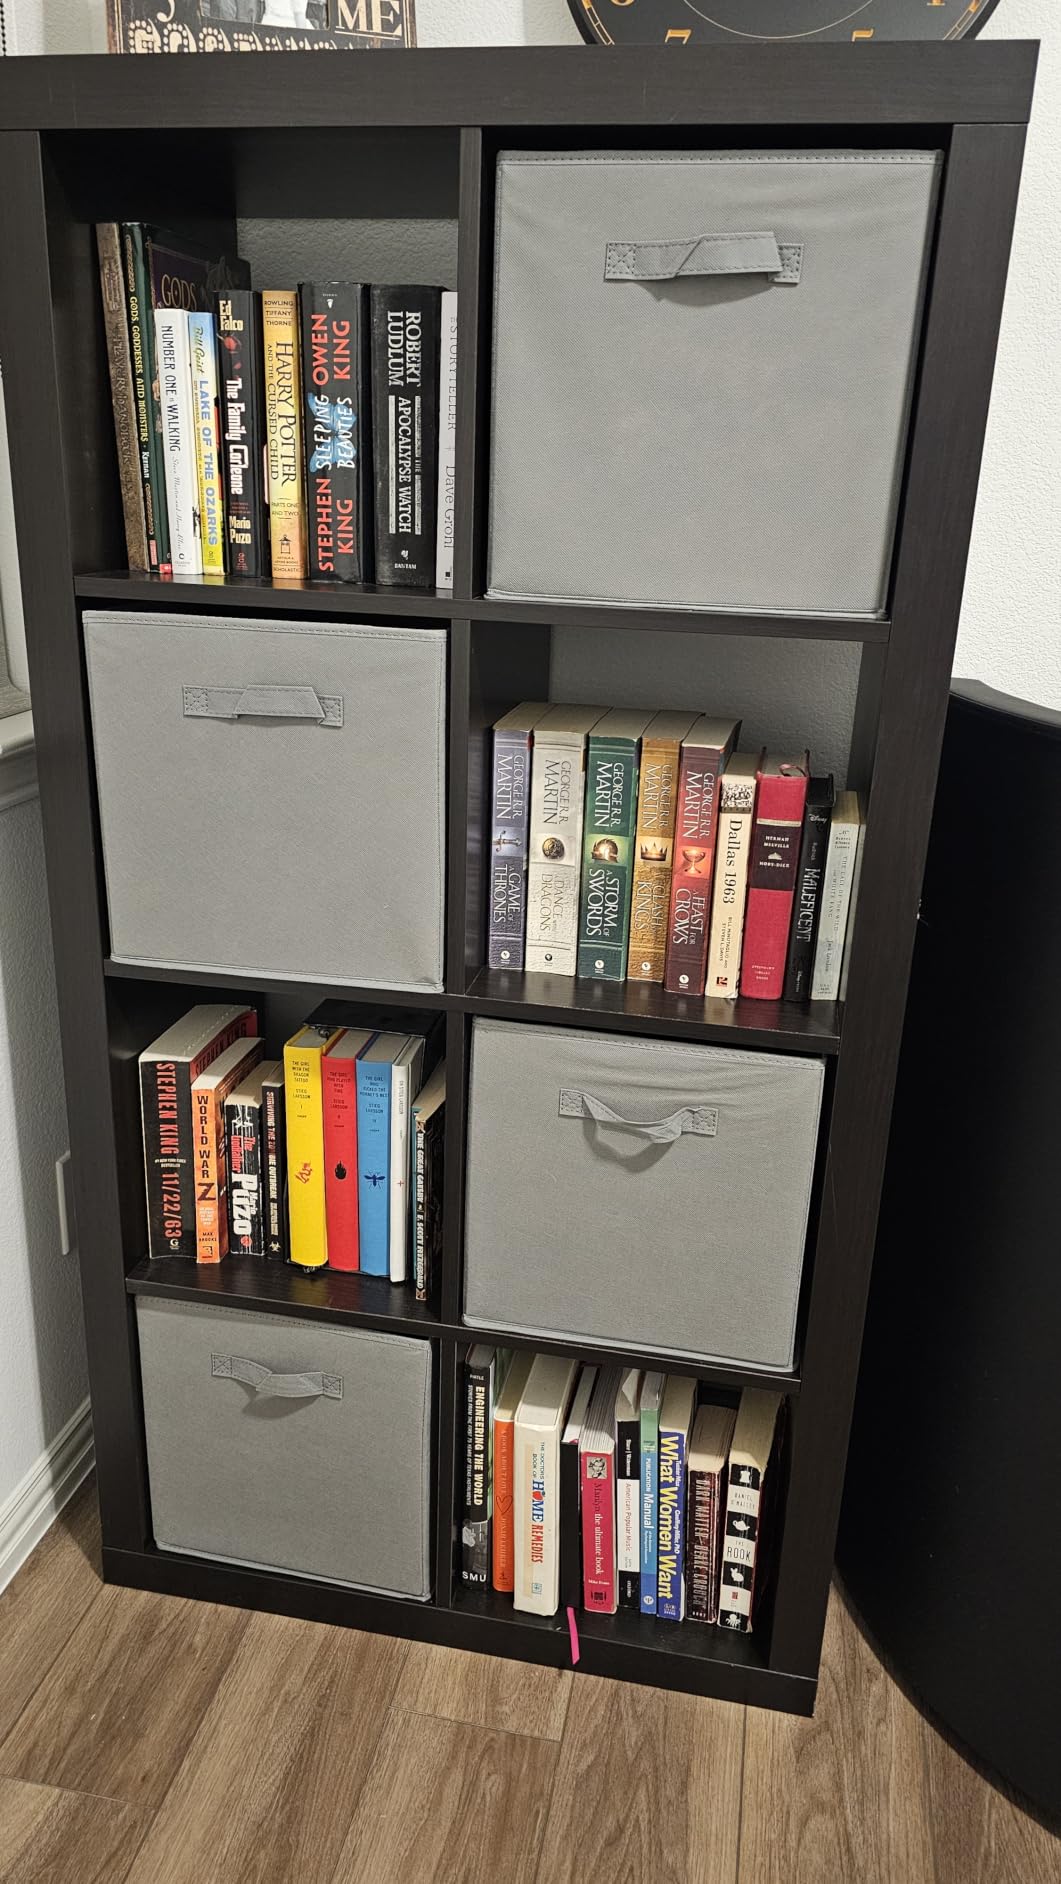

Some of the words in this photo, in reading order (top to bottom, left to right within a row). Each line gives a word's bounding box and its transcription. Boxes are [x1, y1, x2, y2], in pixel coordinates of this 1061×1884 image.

[219, 300, 232, 316] Ed
[220, 316, 244, 331] Falco
[161, 325, 176, 370] NUMBER
[193, 326, 204, 346] Bill
[311, 314, 329, 386] OWEN
[332, 320, 351, 380] KING
[387, 310, 404, 387] LUDLUM
[405, 311, 422, 388] ROBERT
[194, 347, 206, 374] Geist
[276, 341, 294, 409] HARRY
[165, 376, 177, 396] ONE
[199, 380, 210, 420] LAKE
[226, 377, 243, 399] The
[167, 403, 181, 452] WALKING
[225, 402, 246, 441] Family
[267, 383, 278, 436] CURSED
[202, 428, 212, 447] OF
[277, 412, 297, 487] POTTER
[313, 393, 332, 471] SLEEPING
[336, 396, 356, 469] BEAUTIES
[398, 396, 412, 483] APOCALYPSE
[204, 453, 214, 480] THE
[229, 444, 249, 495] Corleone
[269, 439, 279, 481] CHILD
[444, 465, 456, 504] Dave
[205, 487, 218, 546] OZARKS
[229, 515, 251, 529] Mario
[316, 478, 335, 572] STEPHEN
[336, 499, 354, 554] KING
[398, 486, 412, 533] WATCH
[443, 508, 455, 548] Grohl
[229, 529, 252, 545] Puzo
[496, 754, 513, 820] MARTIN
[512, 755, 525, 798] GEORGE
[543, 759, 560, 825] MARTIN
[560, 760, 572, 803] GEORGE
[594, 760, 613, 828] MARTIN
[611, 762, 625, 806] GEORGE
[642, 763, 661, 829] MARTIN
[660, 764, 672, 808] GEORGE
[700, 772, 715, 817] GEORGE
[682, 770, 703, 839] MARTIN
[726, 820, 743, 867] Dallas
[493, 864, 508, 923] THRONES
[508, 872, 522, 913] GAME
[539, 873, 553, 932] DRAGONS
[552, 881, 565, 918] DANCE
[586, 868, 605, 937] SWORDS
[603, 877, 620, 928] STORM
[634, 880, 653, 930] KINGS
[651, 885, 666, 926] CLASH
[723, 872, 737, 904] 1963
[796, 868, 821, 943] MALEFICENT
[672, 888, 692, 945] CROWS
[690, 896, 706, 934] FEAST
[689, 932, 697, 945] FOR
[156, 1063, 178, 1119] STEPHEN
[266, 1091, 276, 1127] SURVIVING
[160, 1124, 180, 1155] KING
[197, 1095, 209, 1146] WORLD
[267, 1127, 276, 1140] THE
[416, 1132, 425, 1149] THE
[199, 1150, 211, 1179] WAR
[244, 1136, 256, 1152] The
[416, 1149, 425, 1174] GREAT
[197, 1182, 217, 1201] Z
[268, 1166, 278, 1199] OUTBREAK
[416, 1174, 425, 1203] GATSBY
[161, 1172, 182, 1238] 11/22/63
[231, 1172, 258, 1235] Puzo
[249, 1191, 258, 1216] Mario
[416, 1222, 425, 1244] SCOTT
[416, 1245, 425, 1289] FITZGERALD
[474, 1386, 486, 1450] ENGINEERING
[474, 1452, 484, 1473] THE
[660, 1436, 679, 1483] What
[473, 1473, 484, 1506] WORLD
[695, 1479, 711, 1501] DARK
[734, 1492, 753, 1501] DANIEL
[594, 1513, 603, 1526] the
[624, 1512, 632, 1534] Popular
[643, 1493, 655, 1529] Manual
[659, 1486, 678, 1551] Women
[695, 1505, 710, 1538] MATTER
[531, 1524, 544, 1564] REMEDIES
[595, 1526, 604, 1557] ultimate
[693, 1544, 709, 1571] BLAKE
[727, 1546, 752, 1561] ROOK
[462, 1570, 487, 1583] SMU
[596, 1557, 605, 1575] book
[658, 1555, 677, 1599] Want
[692, 1573, 708, 1606] CROUCH
